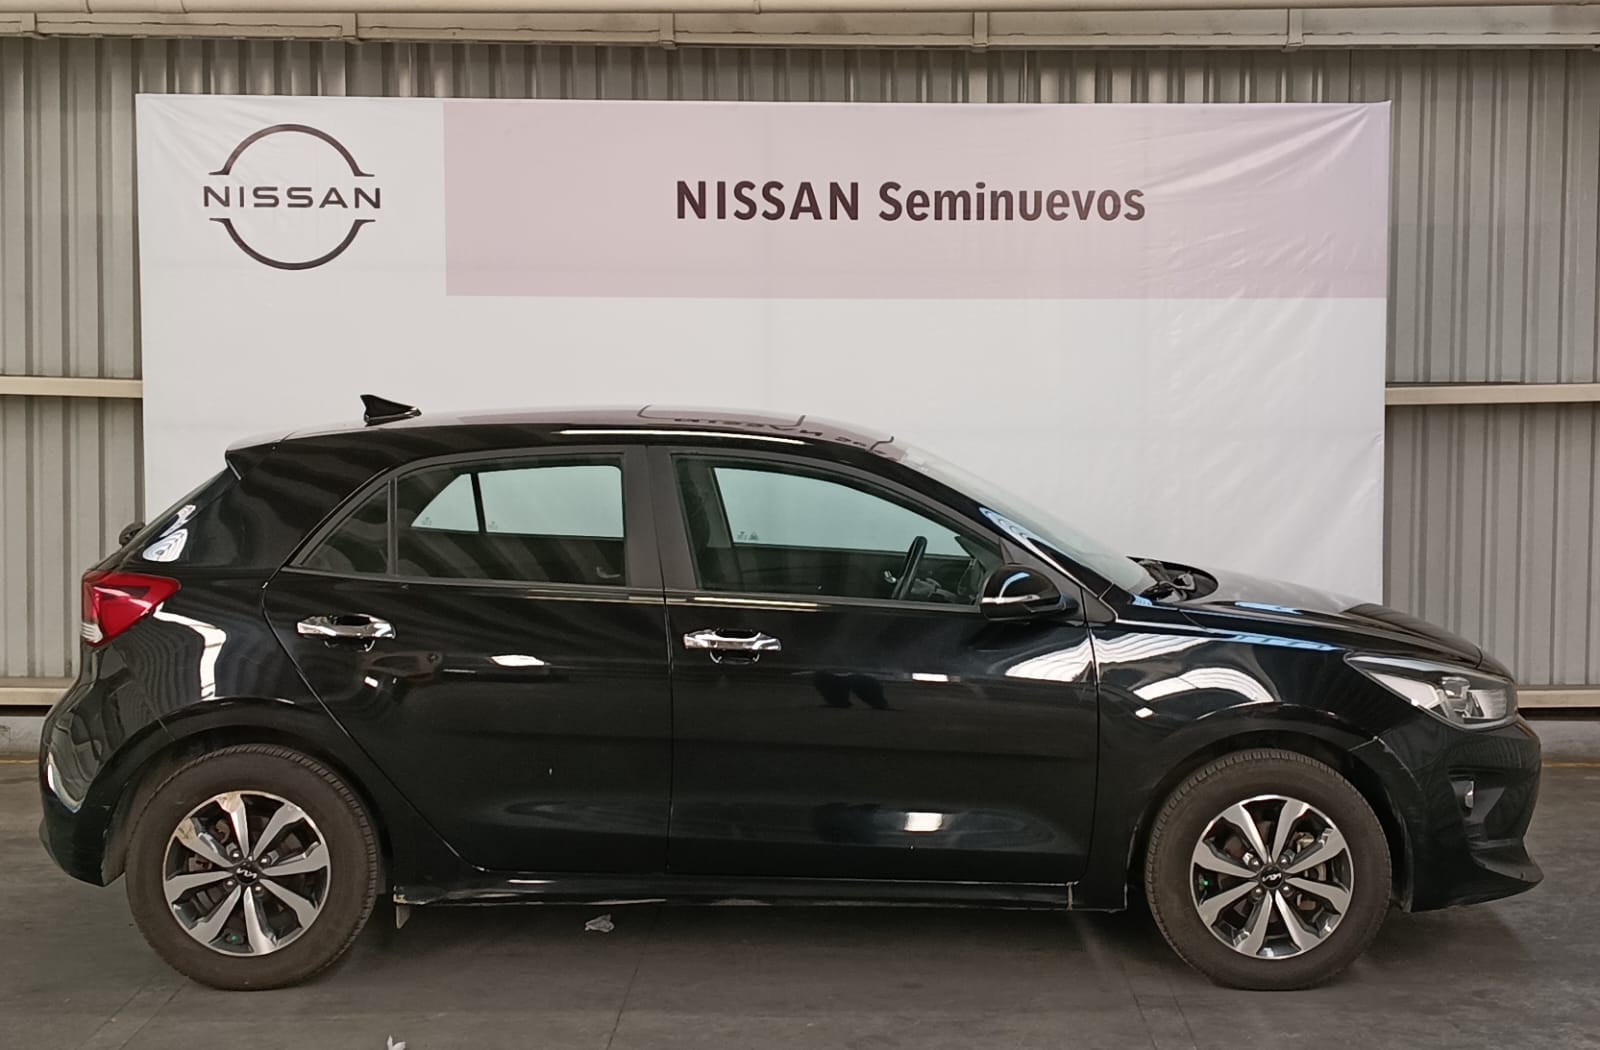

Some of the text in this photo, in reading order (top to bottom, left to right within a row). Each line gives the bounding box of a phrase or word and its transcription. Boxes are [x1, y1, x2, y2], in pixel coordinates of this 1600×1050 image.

[203, 185, 382, 209] NISSAN
[677, 180, 1146, 222] NISSAN Seminuevos
